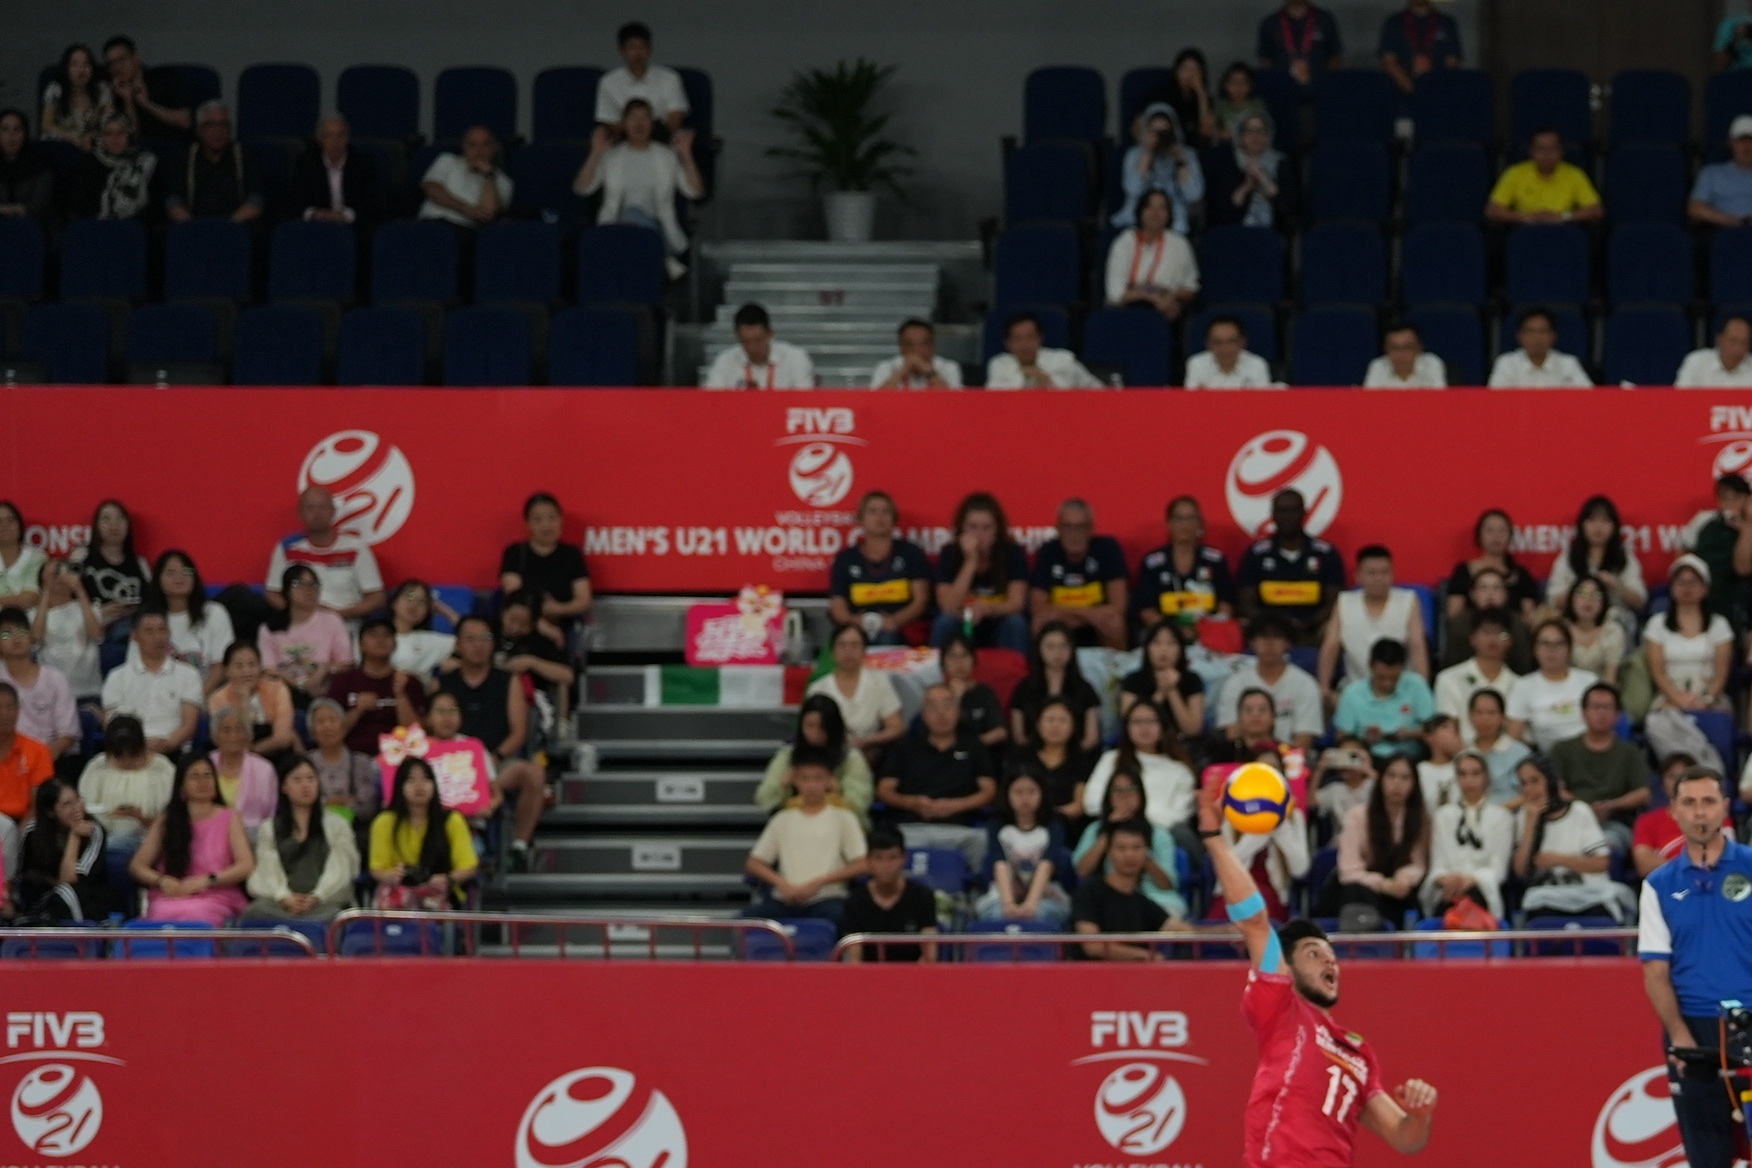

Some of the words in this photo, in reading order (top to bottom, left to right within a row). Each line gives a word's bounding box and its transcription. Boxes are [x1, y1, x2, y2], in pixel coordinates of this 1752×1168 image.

[786, 407, 854, 434] FIVB
[584, 526, 669, 556] MEN'S
[675, 526, 728, 556] U21
[734, 526, 842, 556] WORLD
[7, 1011, 105, 1049] FIVB
[1091, 1010, 1188, 1047] FIVB
[1321, 1063, 1362, 1123] 17
